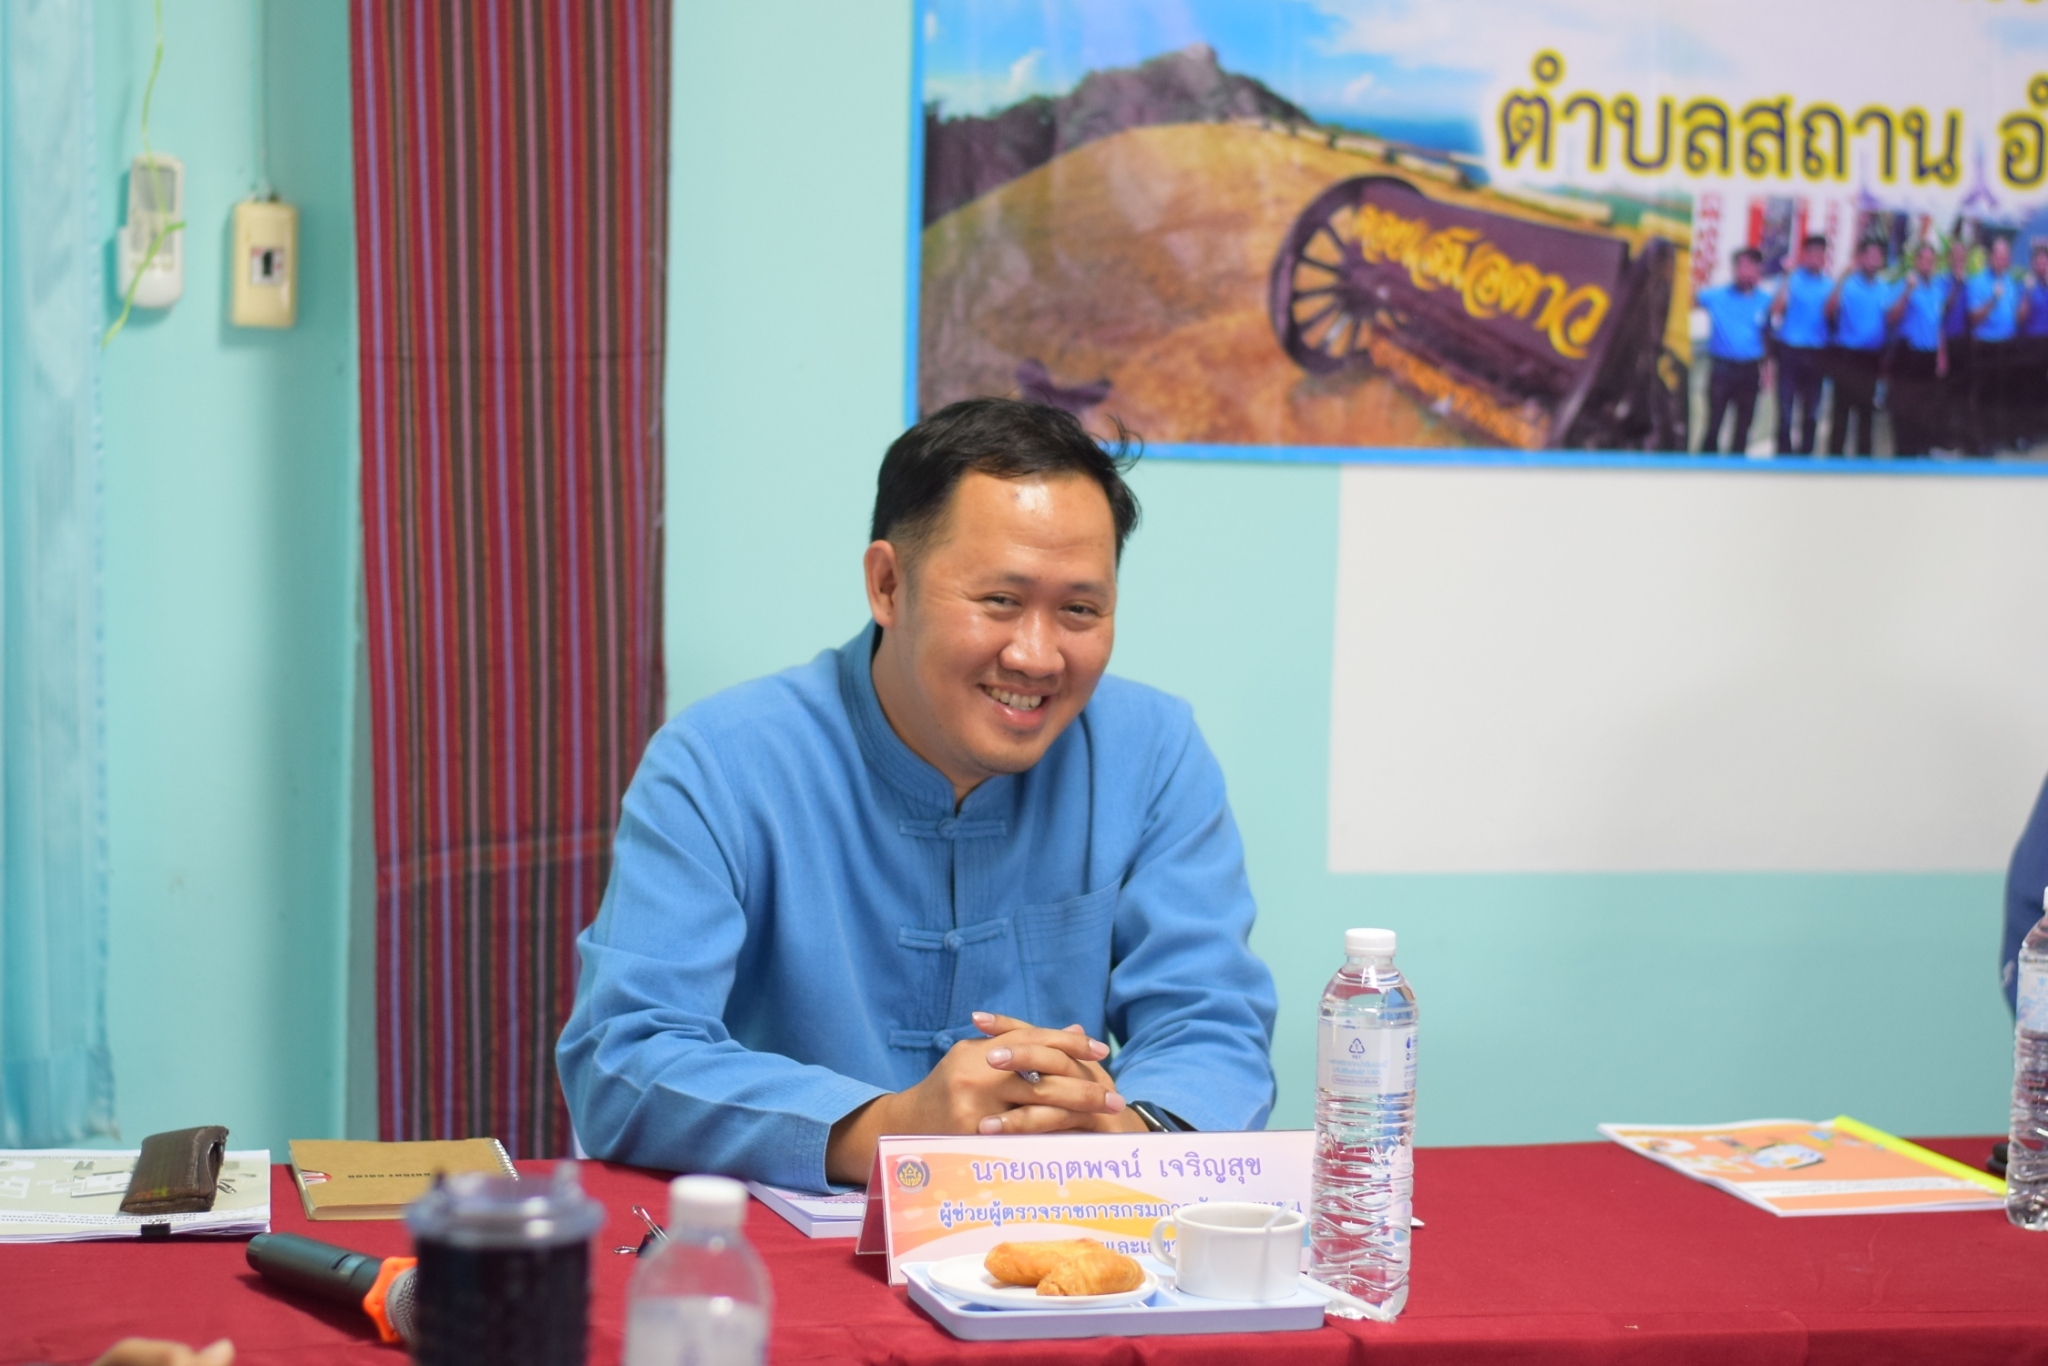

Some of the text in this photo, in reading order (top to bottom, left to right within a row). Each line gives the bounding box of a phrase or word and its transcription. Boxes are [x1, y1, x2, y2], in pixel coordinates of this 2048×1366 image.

[1499, 50, 1963, 186] ตำบลสถาน
[972, 1148, 1262, 1186] นายกฤตพจน์ เจริญสุข
